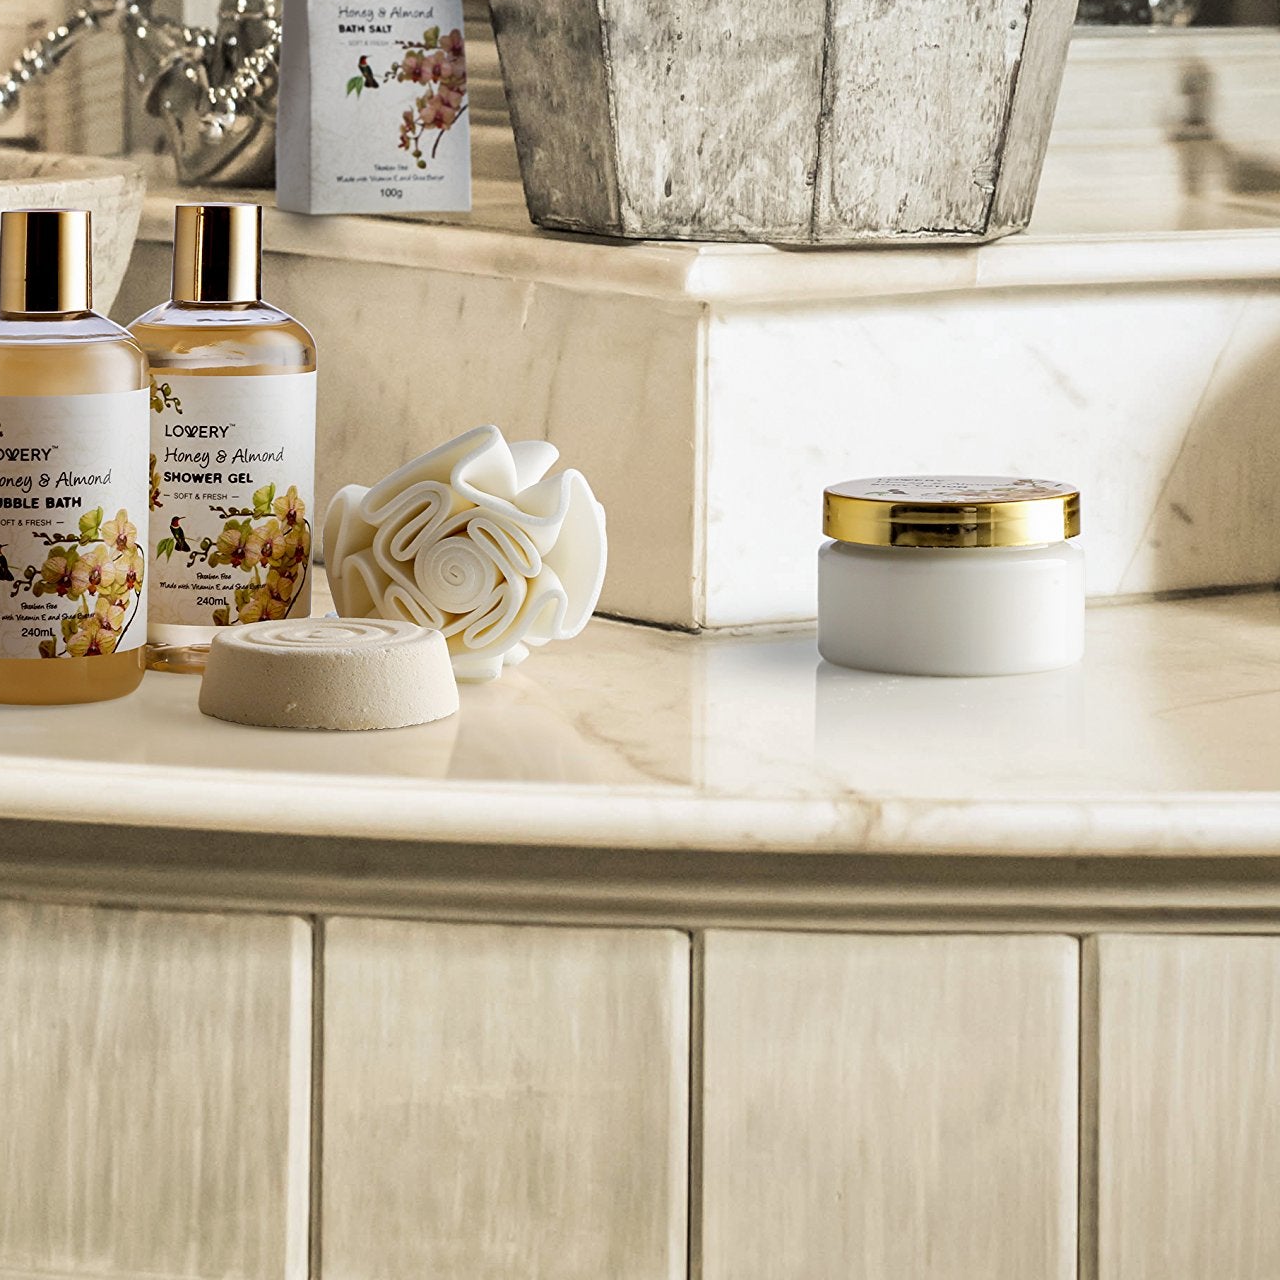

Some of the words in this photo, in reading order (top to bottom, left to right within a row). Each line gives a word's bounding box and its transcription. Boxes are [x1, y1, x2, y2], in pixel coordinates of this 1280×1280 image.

[338, 5, 374, 23] Honey
[377, 7, 387, 18] &
[389, 6, 434, 19] Almond
[338, 24, 365, 33] BATH
[368, 24, 392, 33] SALT
[380, 188, 403, 198] 100g
[164, 446, 210, 469] Honey
[215, 449, 227, 464] &
[231, 446, 284, 464] Almond
[38, 473, 50, 487] &
[55, 468, 112, 488] Almond
[163, 472, 222, 483] SHOWER
[227, 473, 254, 483] GEL
[173, 492, 193, 500] SOFT
[45, 496, 82, 508] BATH
[25, 519, 52, 527] FRESH
[196, 596, 230, 606] 240mL
[21, 627, 56, 637] 240mL
